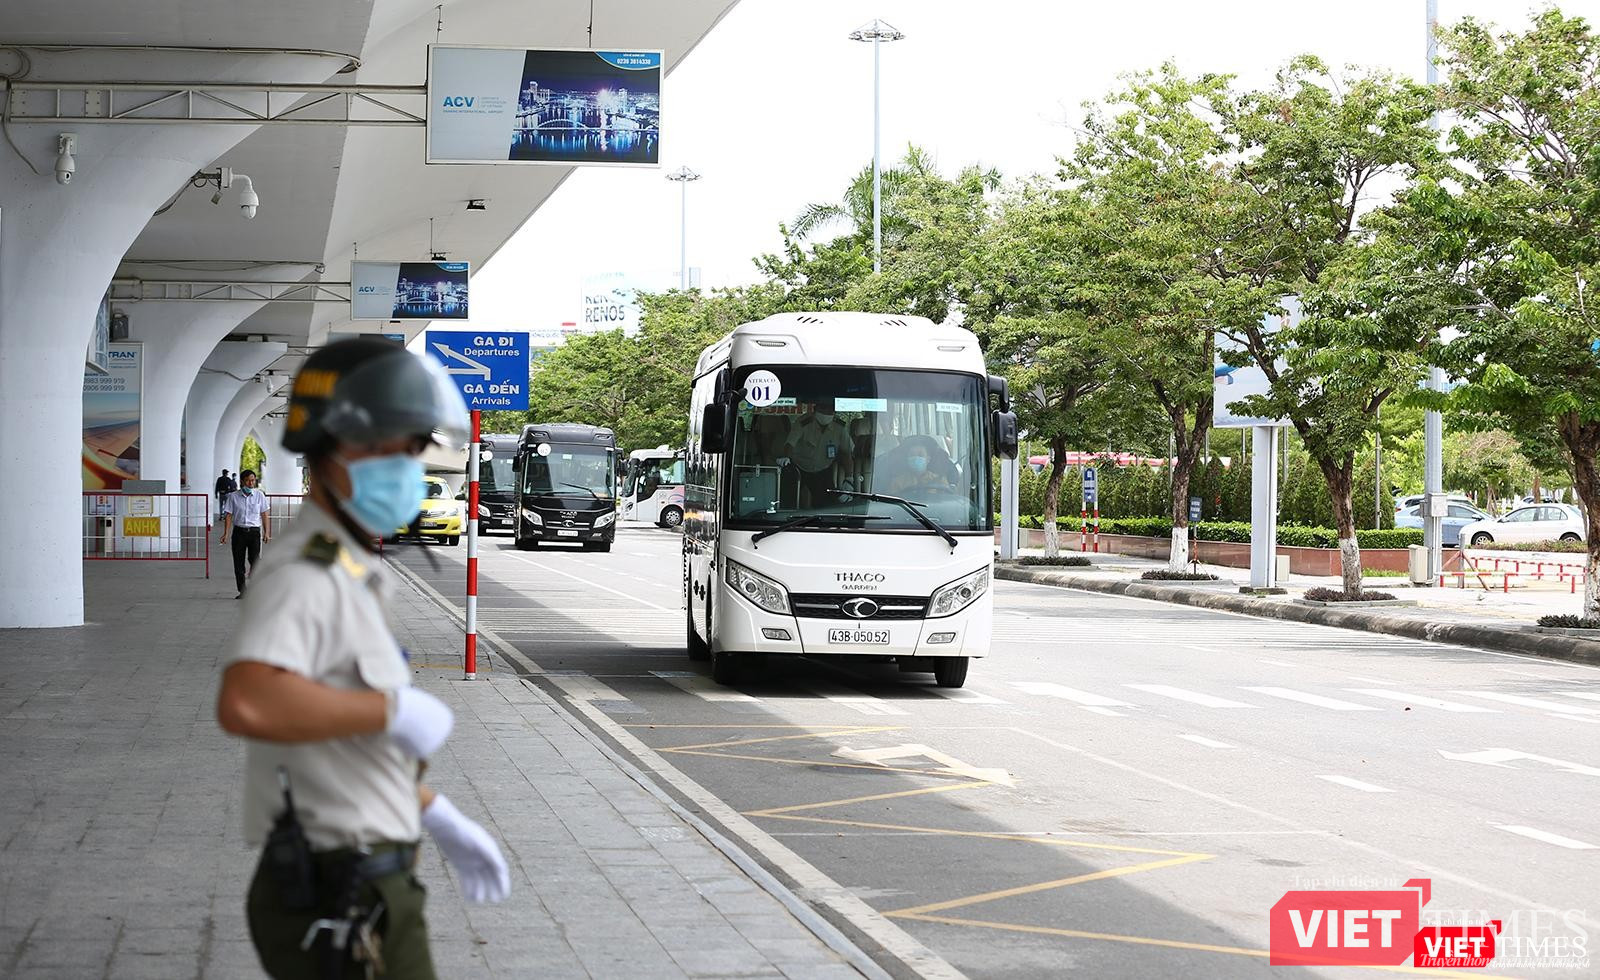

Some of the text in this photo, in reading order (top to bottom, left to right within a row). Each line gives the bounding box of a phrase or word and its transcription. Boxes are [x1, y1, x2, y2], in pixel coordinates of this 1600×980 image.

[443, 96, 475, 107] ACV
[474, 336, 514, 346] GA ĐI
[464, 348, 520, 357] Departures
[464, 379, 520, 394] GA ĐẾN
[751, 386, 771, 401] 01
[472, 397, 511, 405] Arrivals
[125, 520, 159, 534] ANHK
[834, 572, 885, 582] THACO
[831, 631, 888, 643] 43B-050.52
